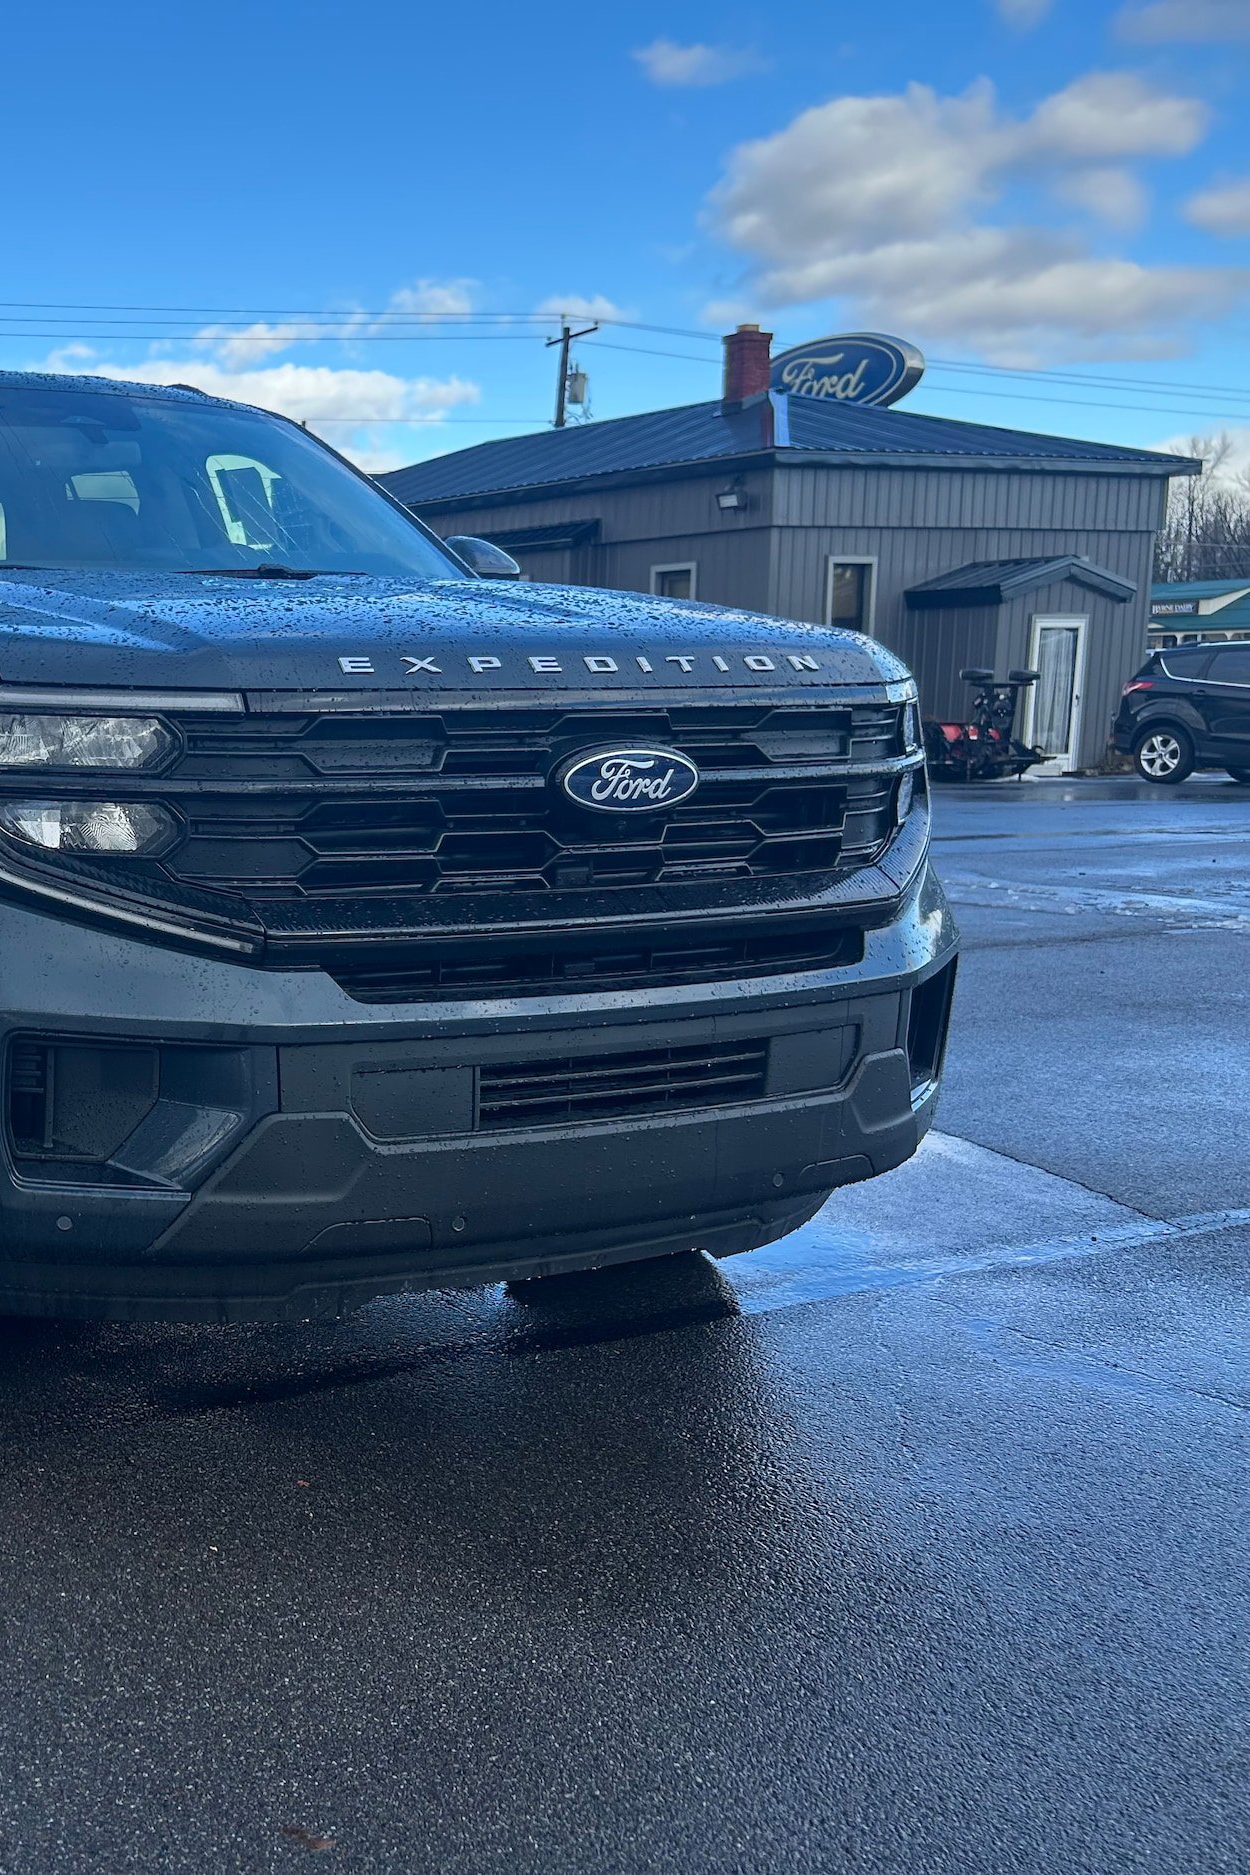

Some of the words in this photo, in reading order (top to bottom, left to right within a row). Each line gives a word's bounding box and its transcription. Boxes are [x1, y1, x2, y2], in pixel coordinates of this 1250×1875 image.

[782, 352, 870, 400] Ford
[337, 655, 819, 674] EXPEDITION
[591, 758, 675, 801] Ford
